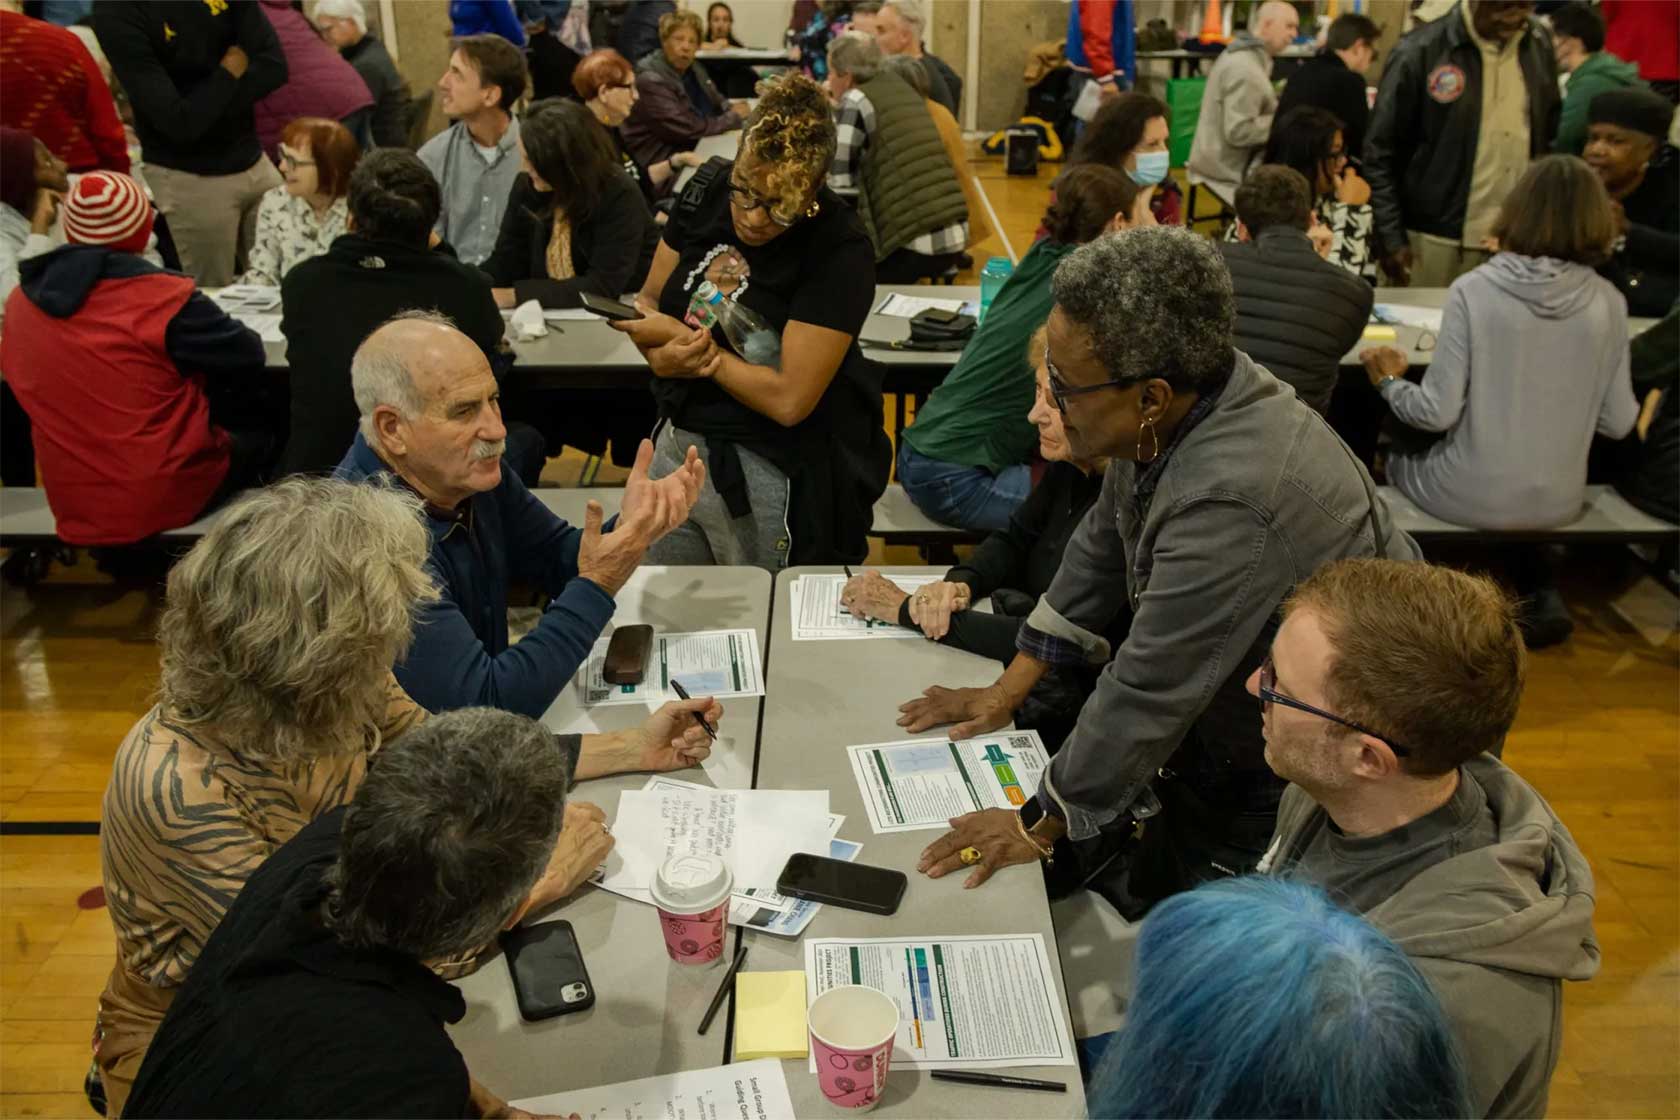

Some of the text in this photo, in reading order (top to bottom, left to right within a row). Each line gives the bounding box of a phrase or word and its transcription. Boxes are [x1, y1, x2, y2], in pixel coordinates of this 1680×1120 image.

[735, 1080, 745, 1104] Guiding
[750, 1077, 760, 1093] Small
[754, 1094, 764, 1114] Group
